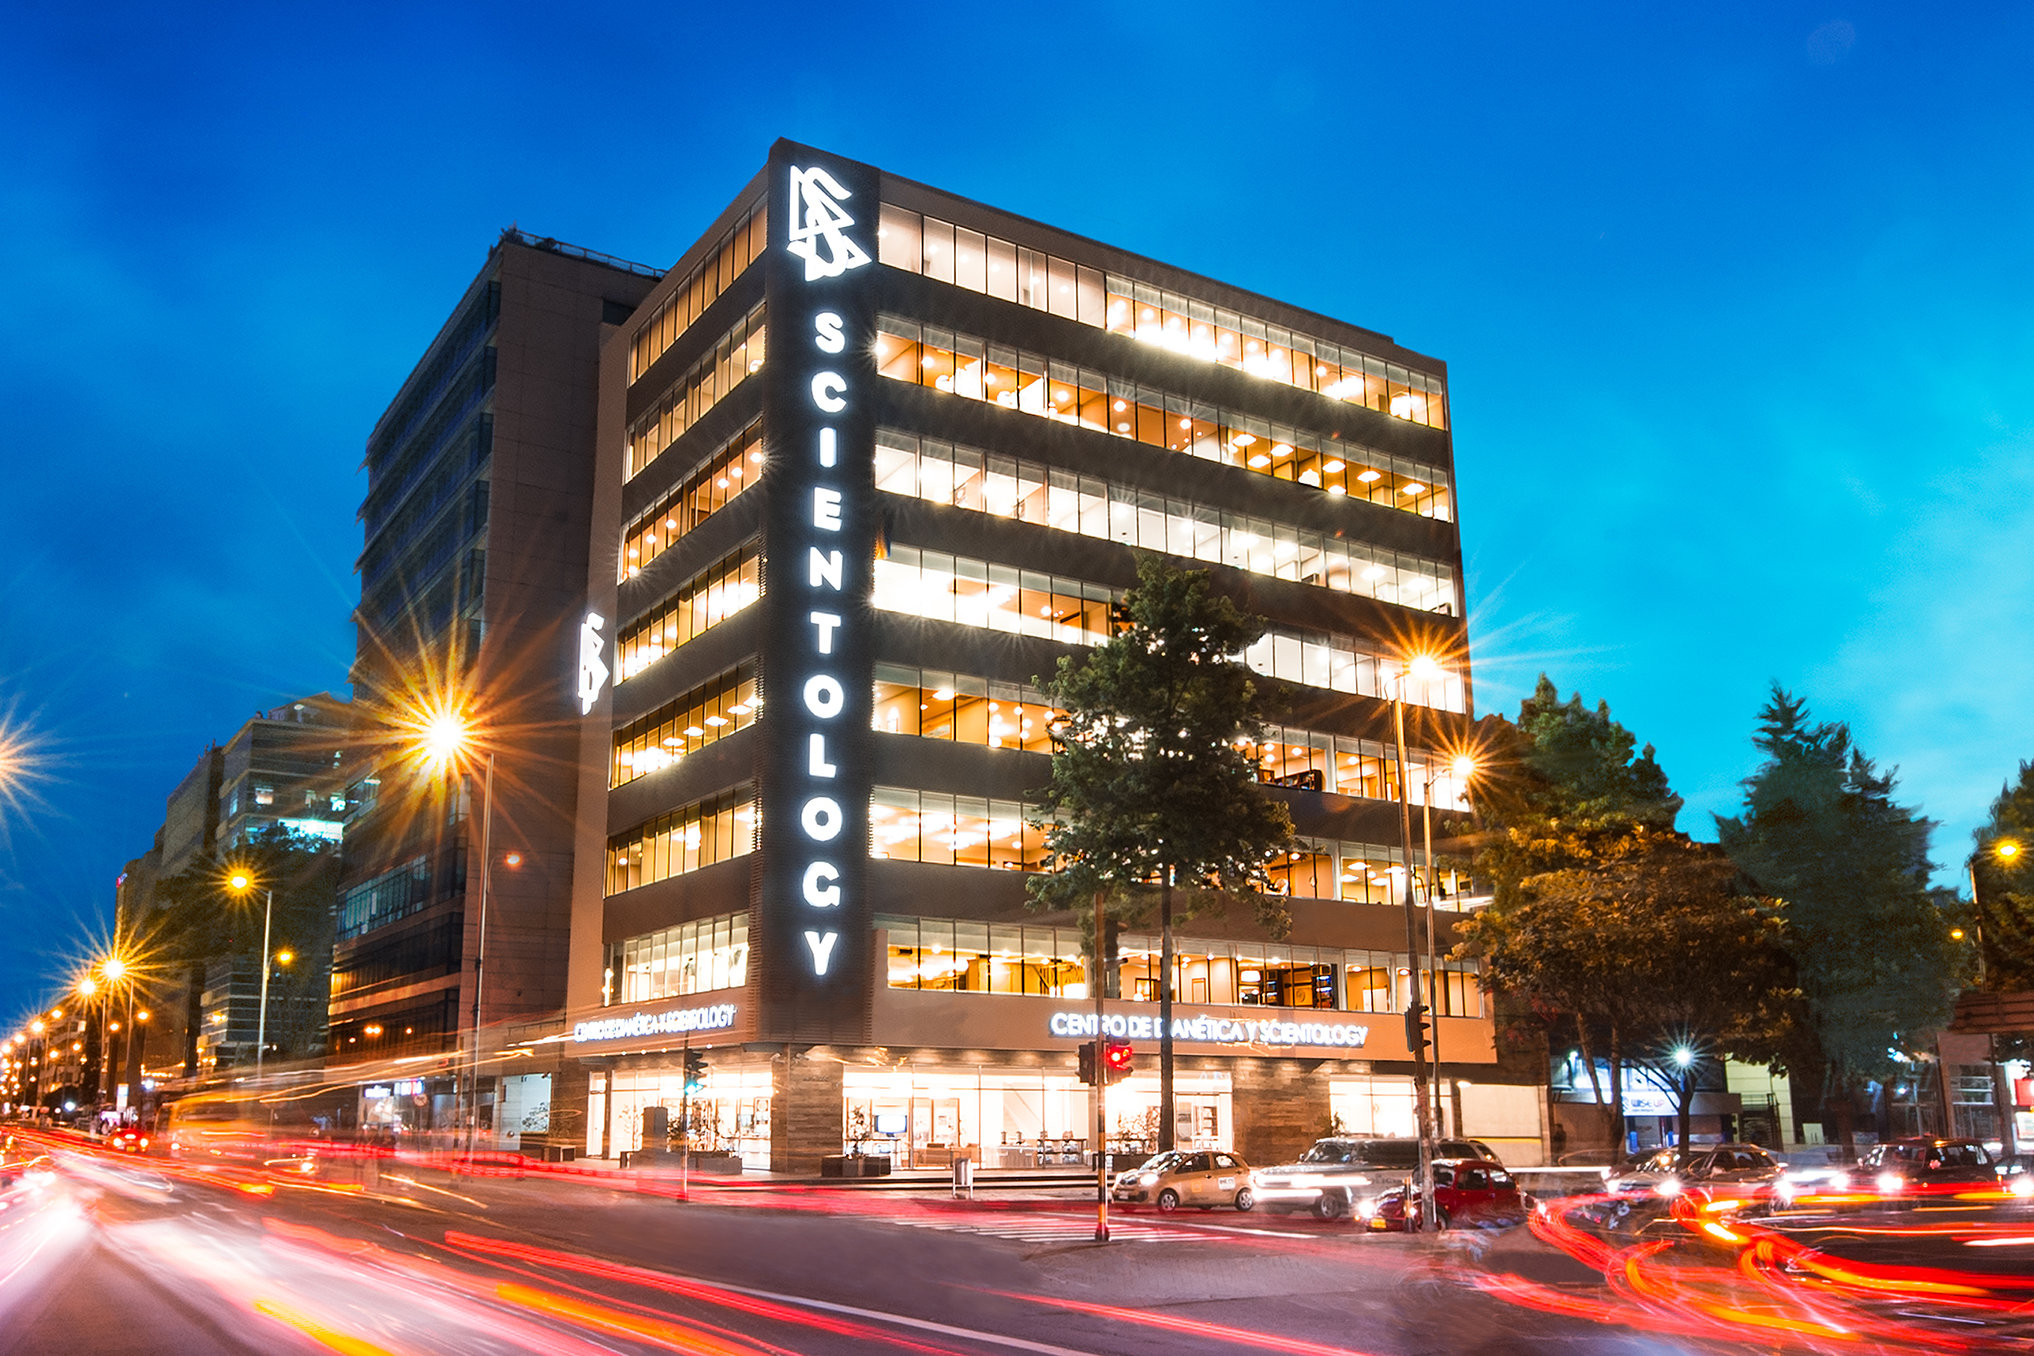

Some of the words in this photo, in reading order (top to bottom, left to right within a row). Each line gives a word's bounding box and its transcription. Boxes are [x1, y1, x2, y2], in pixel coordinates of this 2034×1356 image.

[801, 312, 847, 976] SCIENTOLOGY
[1128, 1016, 1153, 1039] DE
[1154, 1014, 1245, 1042] DANÉTICA
[1245, 1021, 1258, 1043] Y
[1259, 1020, 1369, 1046] SCIENTOLOGY
